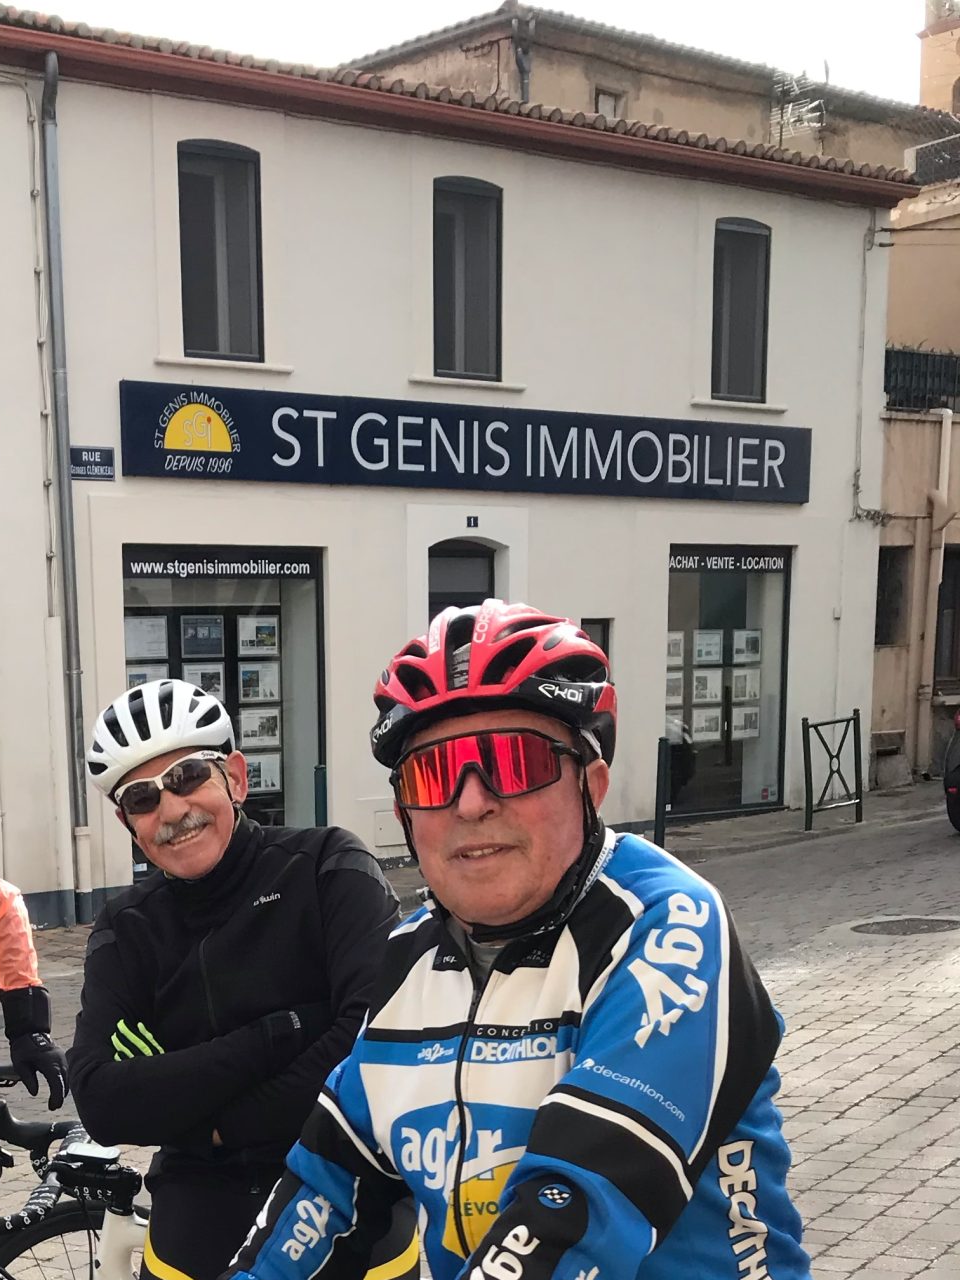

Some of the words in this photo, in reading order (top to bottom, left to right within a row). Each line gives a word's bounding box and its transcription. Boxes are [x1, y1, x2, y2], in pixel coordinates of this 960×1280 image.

[159, 393, 188, 428] GENIS
[190, 391, 241, 453] IMMOBILIER
[82, 451, 101, 462] RUE
[272, 406, 337, 468] ST
[350, 411, 510, 478] GENIS
[525, 423, 787, 489] IMMOBILIER
[164, 454, 206, 473] DEPUIS
[207, 457, 233, 474] 1996
[130, 560, 311, 579] www.stgenisimmobilier.com
[669, 555, 699, 569] ACHAT
[706, 556, 735, 569] VENTE
[741, 557, 785, 570] LOCATION
